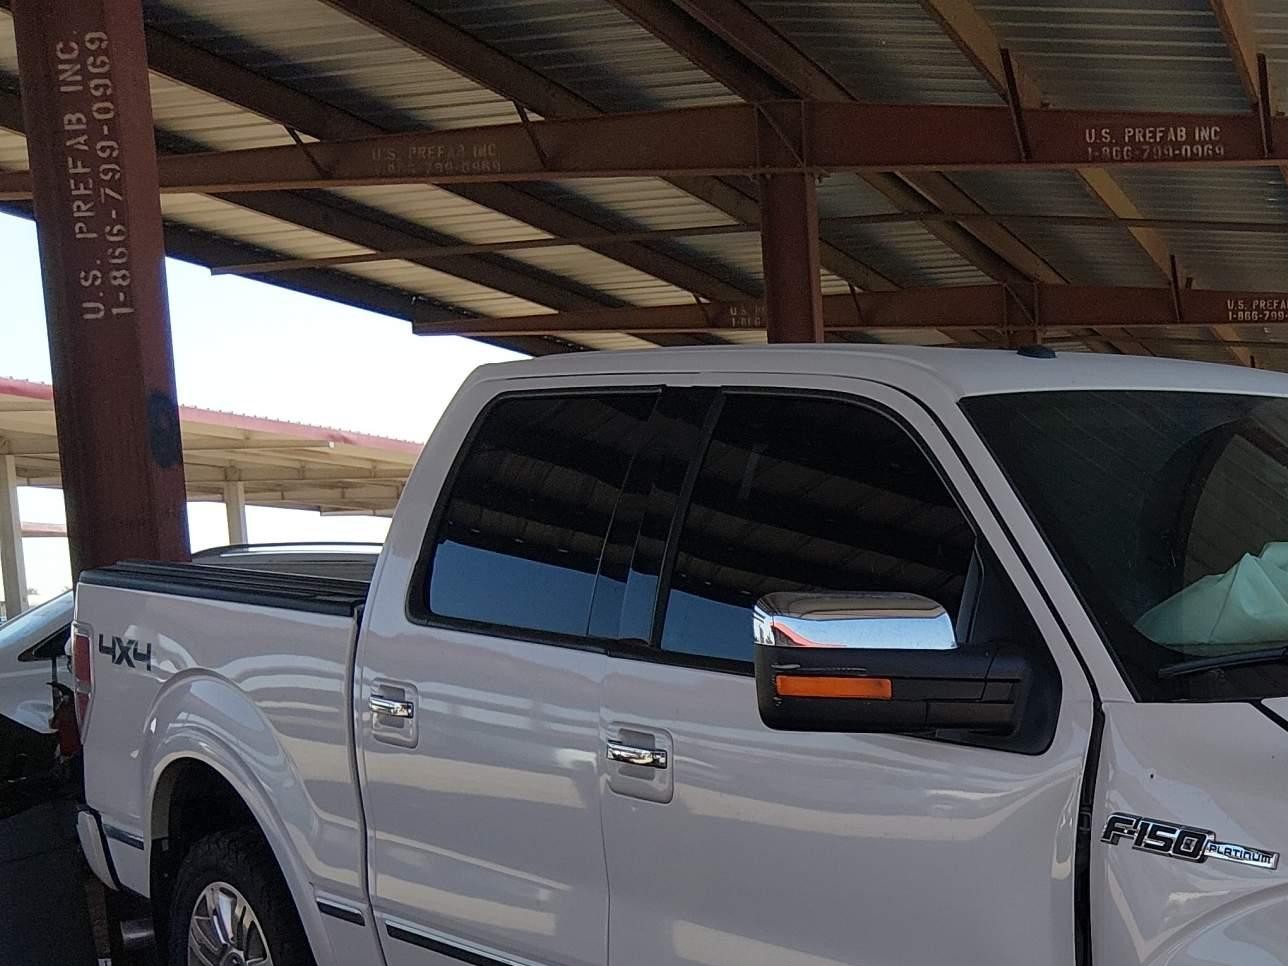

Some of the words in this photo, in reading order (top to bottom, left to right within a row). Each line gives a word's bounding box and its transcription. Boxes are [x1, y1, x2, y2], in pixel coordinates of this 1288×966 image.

[1085, 128, 1116, 143] U.S.
[1124, 127, 1187, 143] PREFAB
[1194, 126, 1221, 142] INC
[63, 111, 99, 240] PREFAB
[84, 31, 135, 316] 1-866-799-0969
[80, 259, 105, 320] U.S.
[1226, 298, 1247, 310] U.S.
[1208, 843, 1273, 865] PLATINUM
